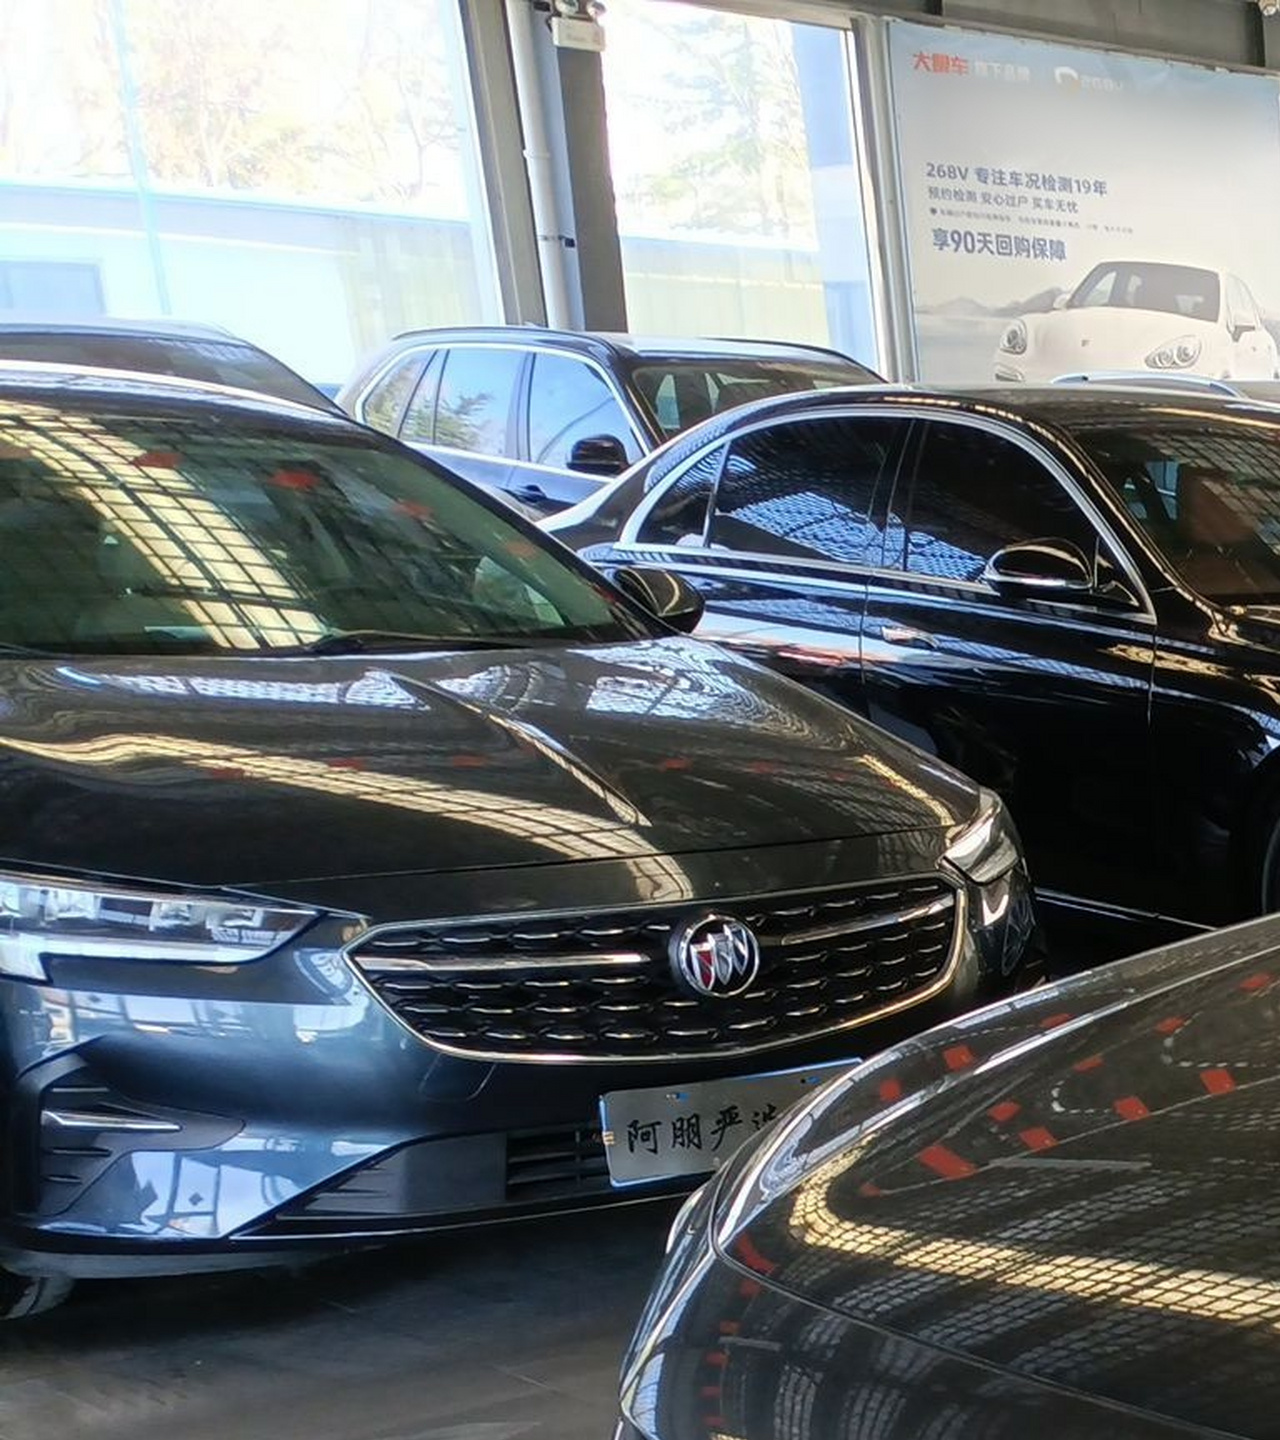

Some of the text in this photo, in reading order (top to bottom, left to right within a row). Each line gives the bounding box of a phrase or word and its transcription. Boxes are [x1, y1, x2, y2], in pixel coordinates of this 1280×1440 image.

[926, 162, 1108, 196] 268V 专注车况检测19年
[932, 227, 1066, 261] 享90天回购保障
